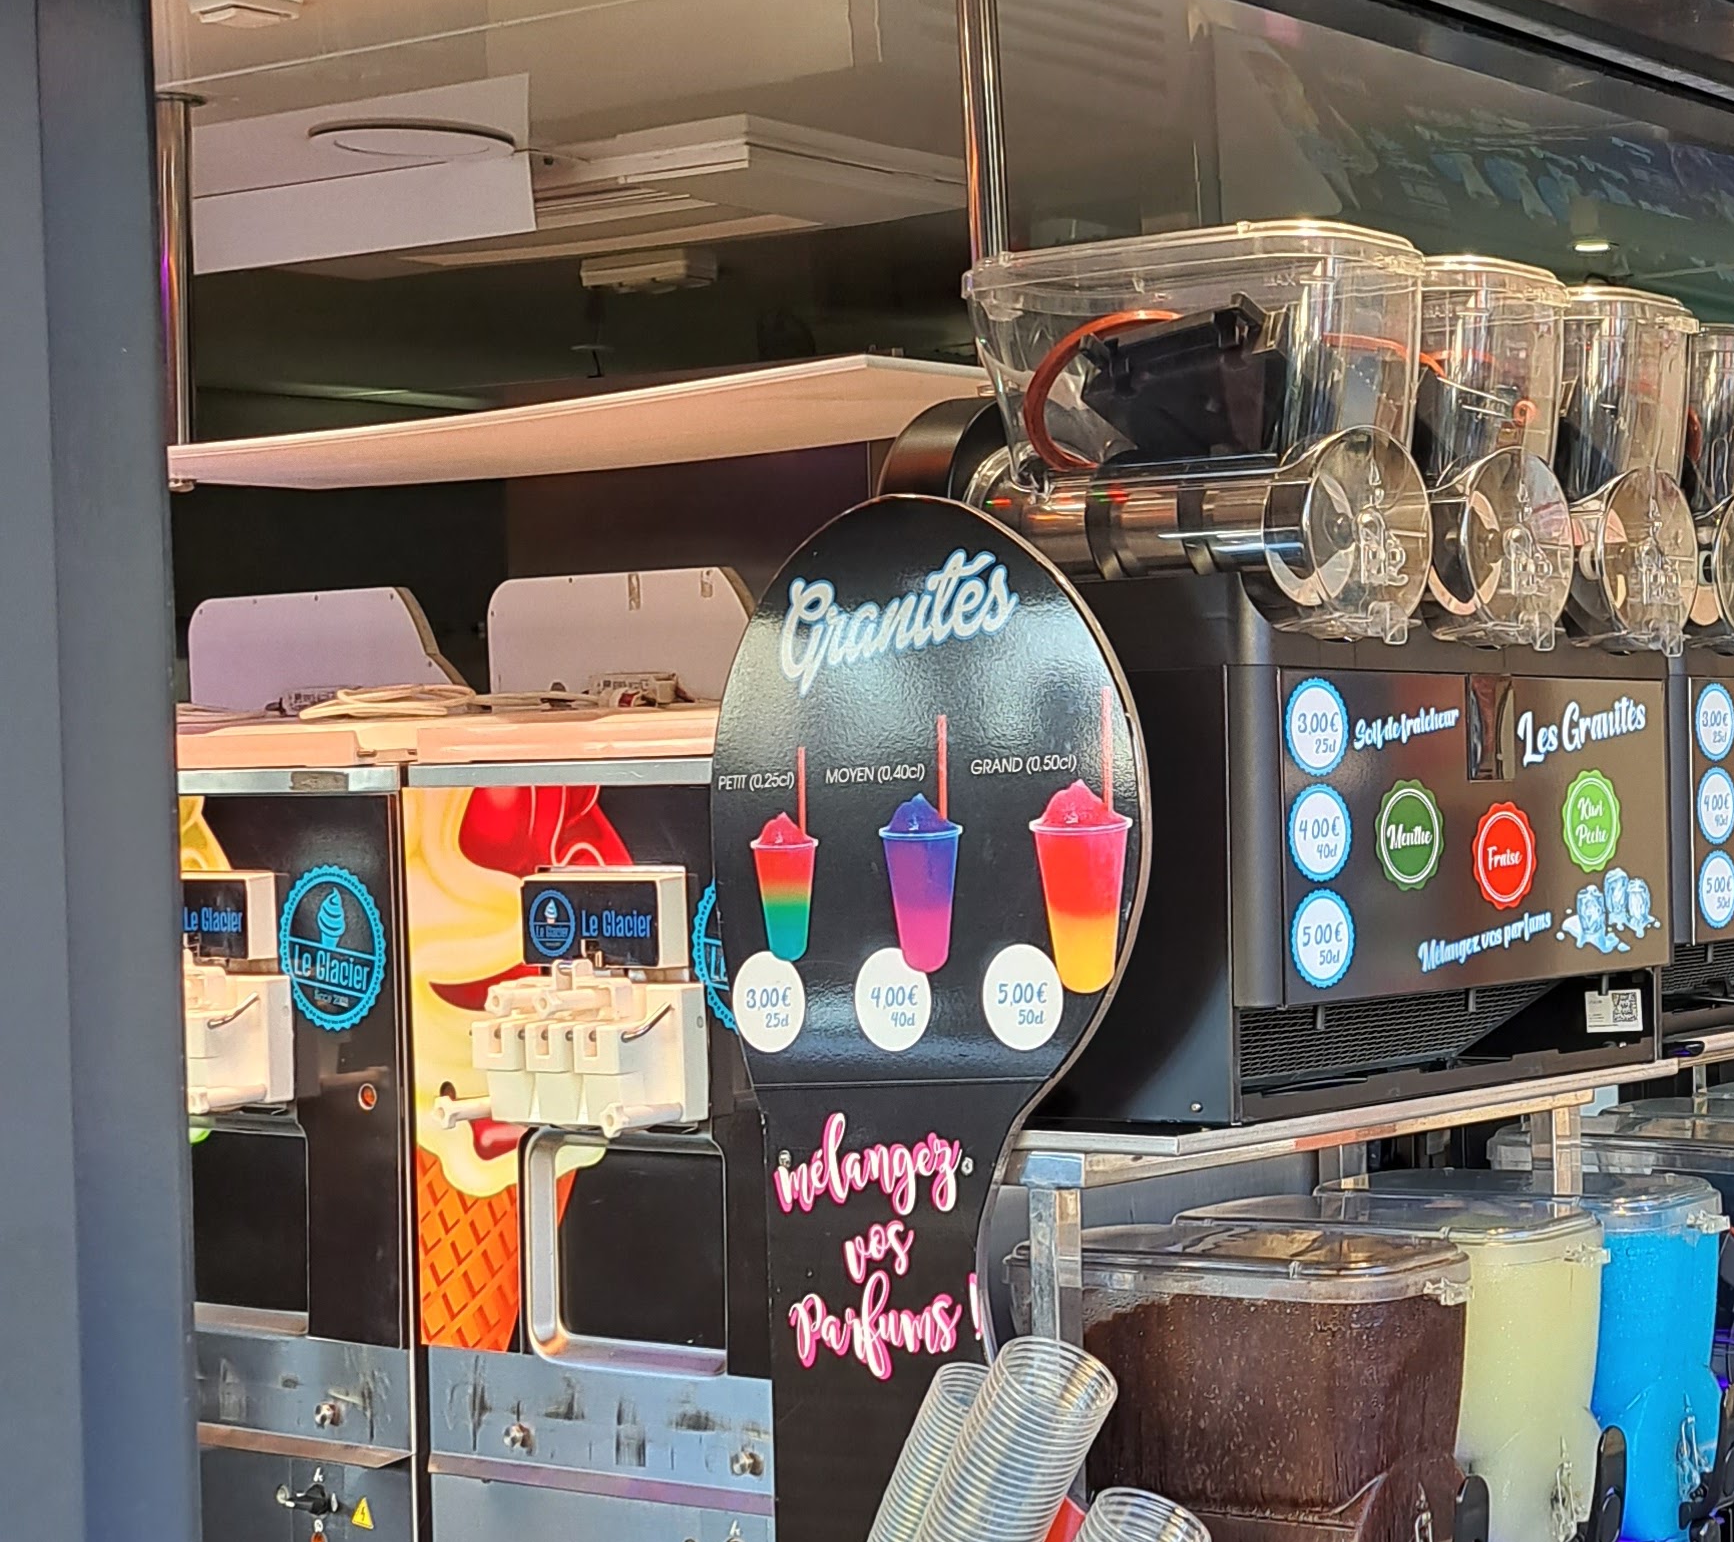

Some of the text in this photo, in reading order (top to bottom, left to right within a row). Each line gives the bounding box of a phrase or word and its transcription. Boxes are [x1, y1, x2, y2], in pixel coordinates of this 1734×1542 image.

[780, 547, 1021, 695] Granités
[1384, 715, 1400, 741] de
[1517, 710, 1559, 767] Les
[825, 765, 875, 785] MOYEN
[970, 756, 1023, 776] GRAND
[717, 773, 747, 791] PETIT
[1577, 796, 1604, 821] Kiwi
[1386, 823, 1434, 851] Menthe
[1487, 845, 1524, 871] Fraise
[183, 906, 243, 933] Le Glacier
[581, 909, 653, 939] Le Glacier
[1481, 911, 1552, 949] vos parfums
[293, 944, 371, 991] Le Glacier
[746, 985, 792, 1010] 3,00€
[870, 984, 919, 1009] 4,00€
[997, 981, 1049, 1008] 5,00€
[843, 1220, 915, 1285] vos
[788, 1269, 963, 1380] Parfums
